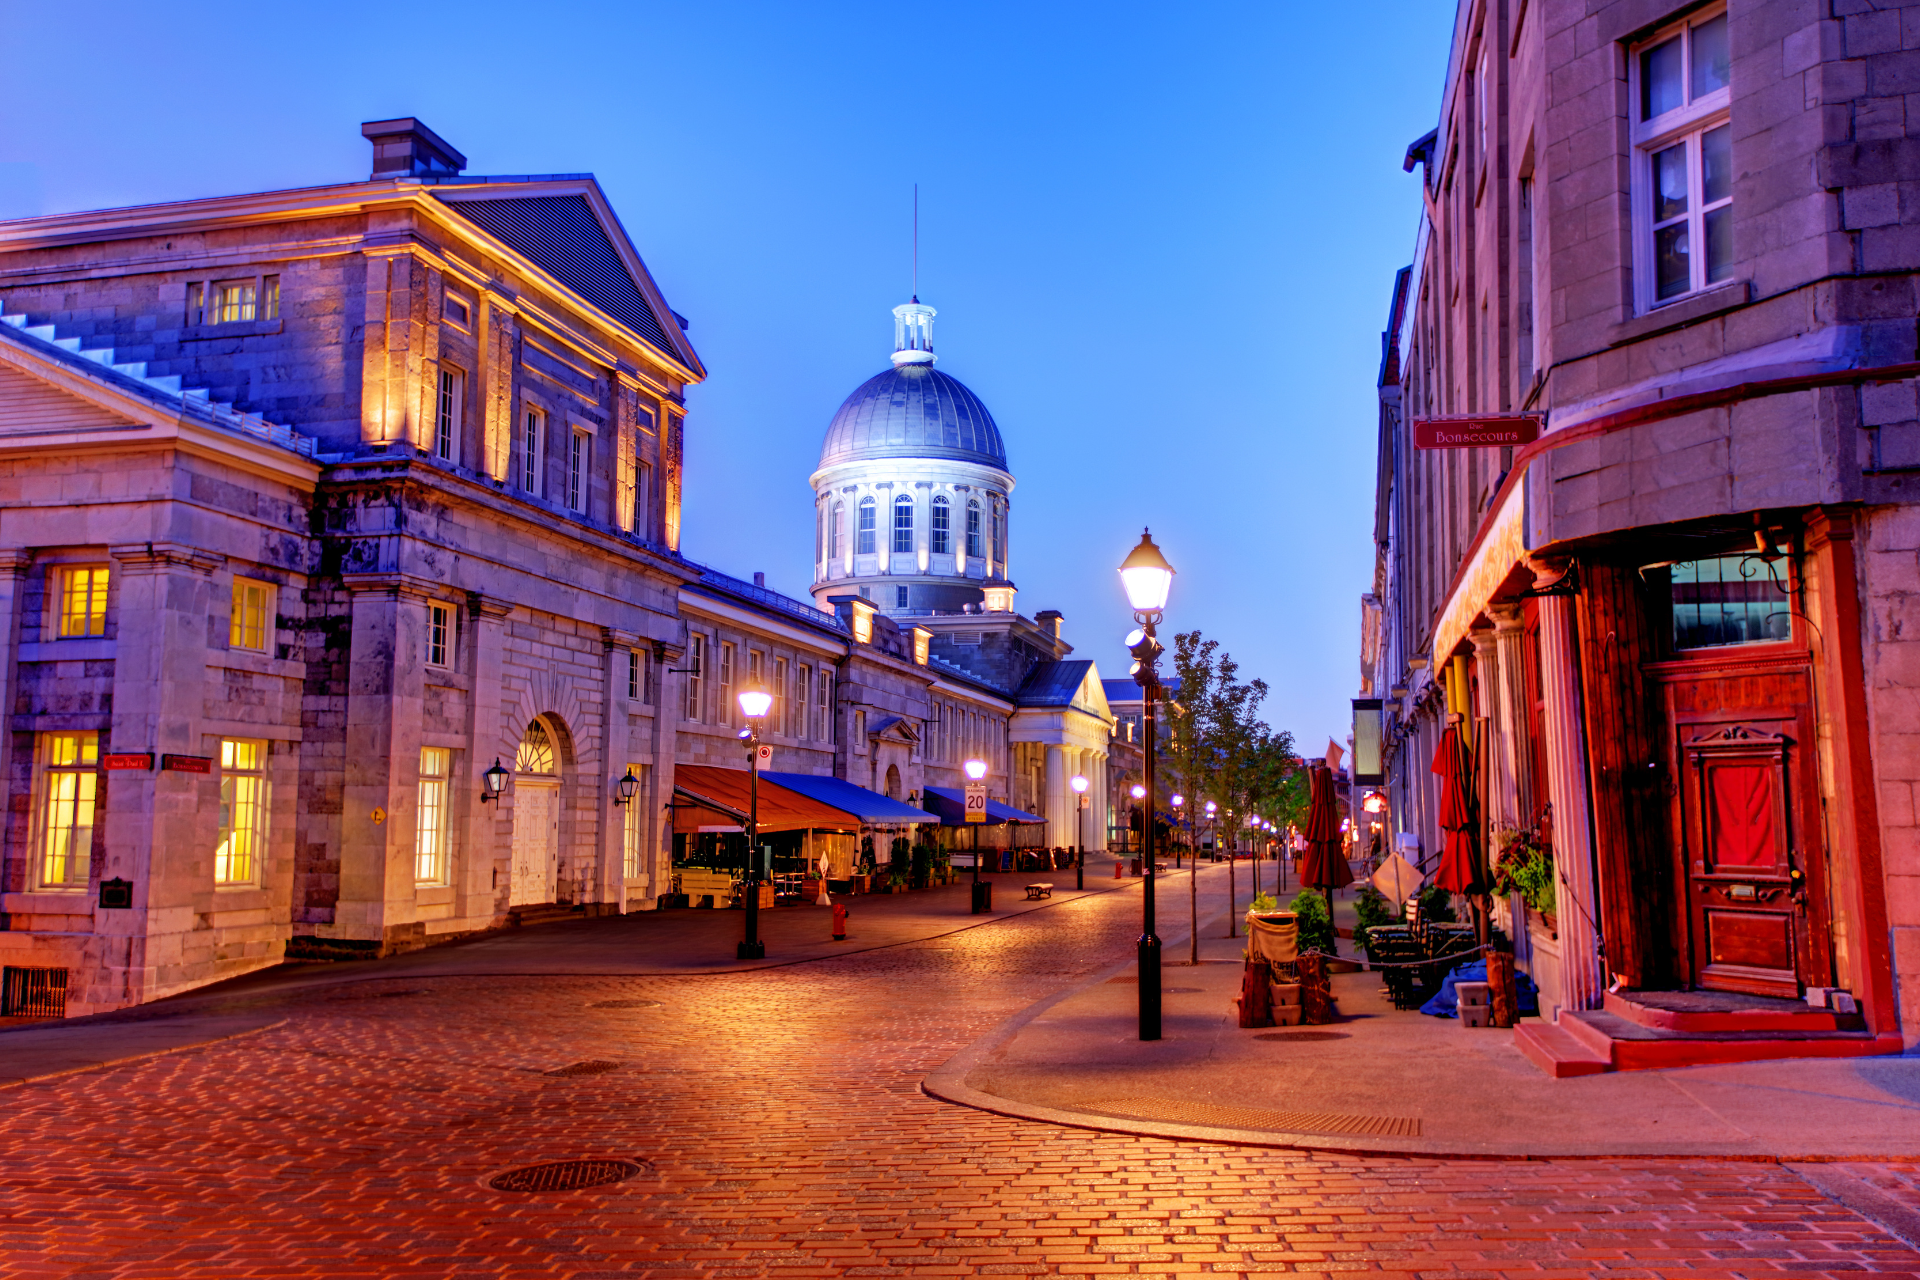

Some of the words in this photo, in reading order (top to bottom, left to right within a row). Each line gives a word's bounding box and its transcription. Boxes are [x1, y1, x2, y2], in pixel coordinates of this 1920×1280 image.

[1468, 422, 1484, 430] Rue
[1435, 431, 1518, 443] Bonsecours
[967, 795, 984, 809] 20
